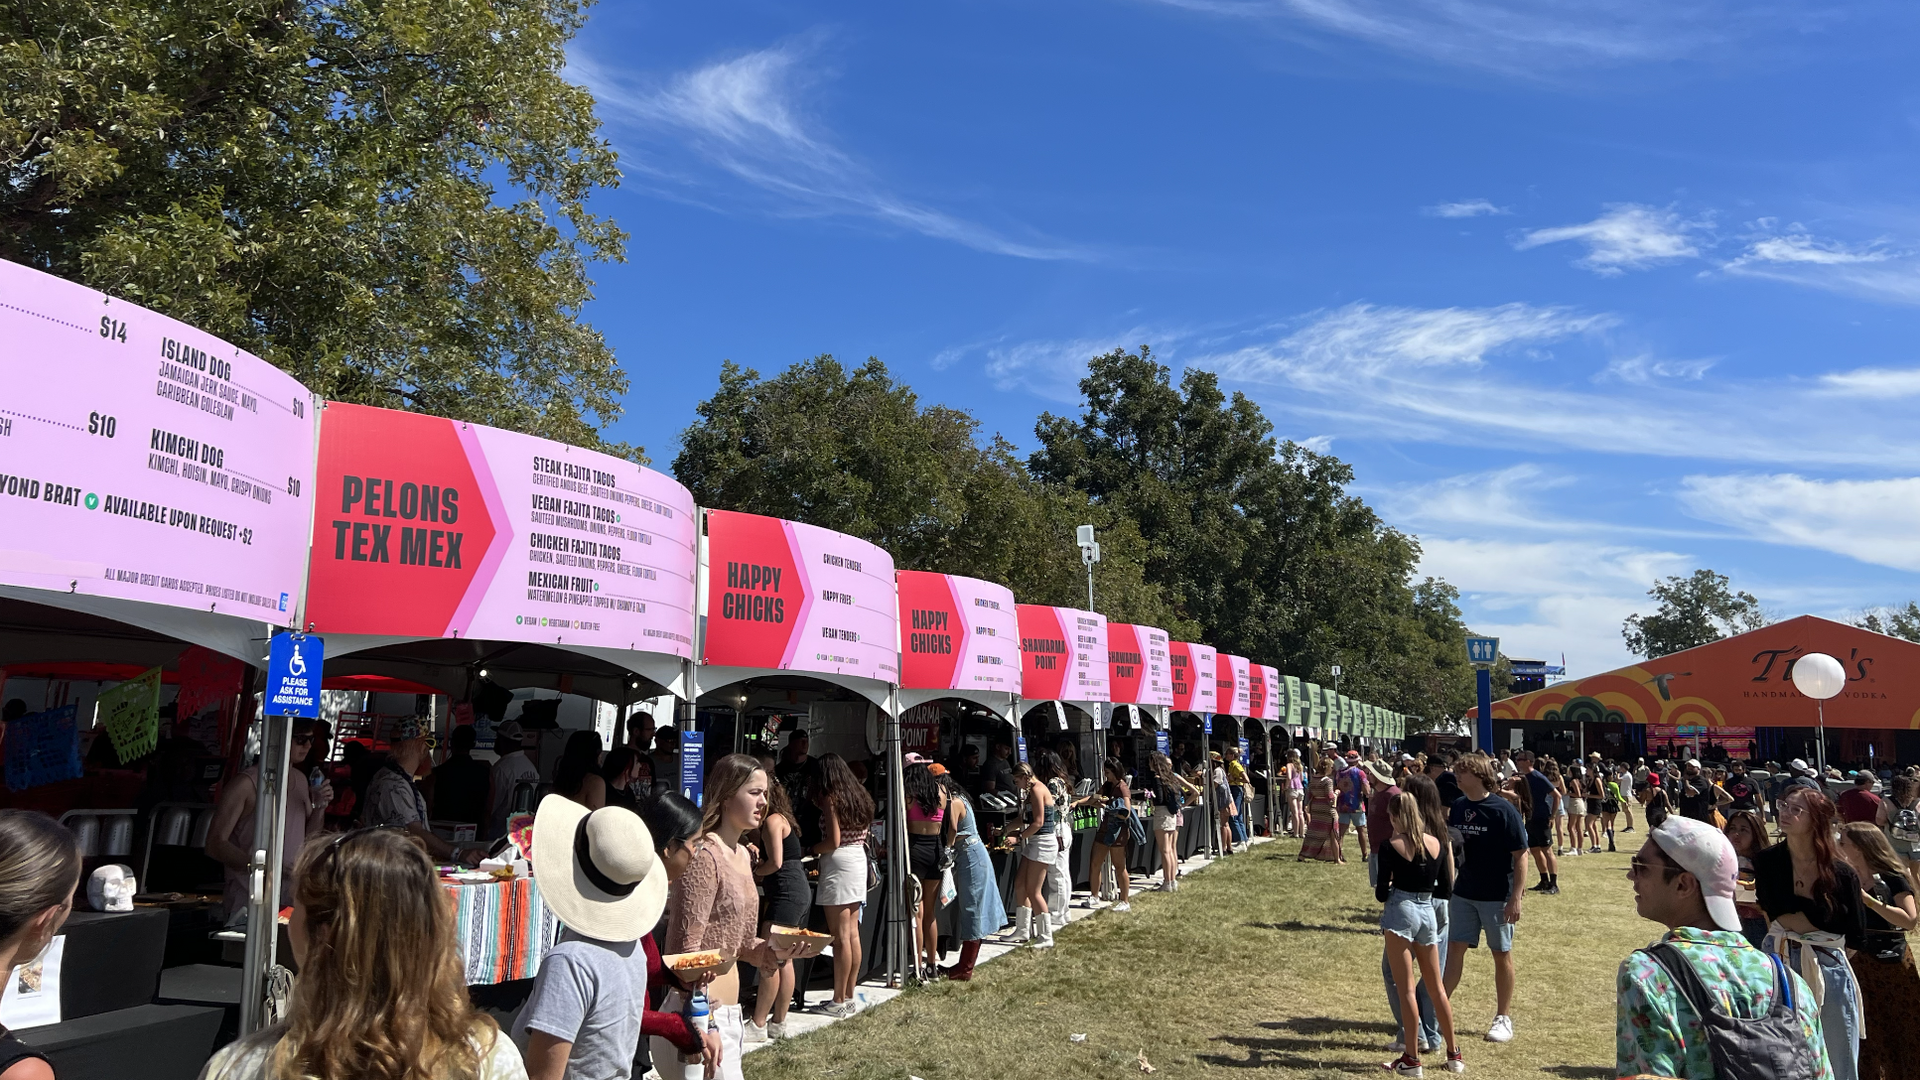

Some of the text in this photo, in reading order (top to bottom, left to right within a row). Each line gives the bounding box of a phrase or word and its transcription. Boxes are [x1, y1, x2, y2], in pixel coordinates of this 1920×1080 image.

[100, 315, 127, 345] $14
[161, 336, 231, 382] ISLAND DOG
[159, 360, 258, 415] JAMAICAN JERK SAUCE, MAYO,
[156, 380, 234, 421] CARIBBEAN COLESLAW
[292, 397, 304, 420] $10
[88, 409, 117, 439] $10
[150, 428, 224, 469] KIMCHI DOG
[148, 453, 272, 505] KIMCHI, HOISIN, MAYO, CRISPY ONIONS
[532, 473, 559, 489] CERTIFIED
[560, 478, 577, 492] ANGUS
[533, 456, 616, 488] STEAK FAJITA TACOS
[287, 476, 301, 498] $10
[342, 475, 459, 525] PELONS
[532, 493, 616, 524] VEGAN FAJITA TACOS
[43, 482, 81, 507] BRAT
[104, 494, 167, 525] AVAILABLE
[169, 508, 198, 531] UPON
[199, 516, 238, 541] REQUEST
[239, 527, 253, 545] +$2
[530, 511, 555, 526] SAUTEED
[333, 520, 463, 569] TEX MEX
[530, 532, 621, 561] CHICKEN FAJITA TACOS
[529, 549, 554, 564] CHICKEN,
[823, 553, 862, 573] CHICKEN TENDERS
[104, 568, 116, 580] ALL
[117, 570, 139, 584] MAJOR
[140, 573, 160, 587] CREDIT
[160, 577, 178, 590] CARDS
[528, 571, 593, 593] MEXICAN FRUIT
[728, 561, 782, 593] HAPPY
[527, 588, 563, 604] WATERMELON
[568, 592, 593, 607] PINEAPPLE
[723, 592, 784, 624] CHICKS
[822, 590, 852, 605] HAPPY FRIES
[912, 609, 948, 631] HAPPY
[822, 627, 857, 643] VEGAN TENDERS
[910, 632, 952, 655] CHICKS
[1022, 638, 1066, 655] SHAWARMA
[1034, 655, 1057, 670] POINT
[1116, 665, 1135, 679] POINT
[1170, 654, 1187, 668] SHOW
[1752, 645, 1874, 683] Ti's
[280, 686, 308, 696] ASK FOR
[282, 677, 307, 687] PLEASE
[272, 694, 313, 706] ASSISTANCE
[1744, 691, 1887, 700] HANDMAD VODKA
[901, 728, 928, 747] POINT
